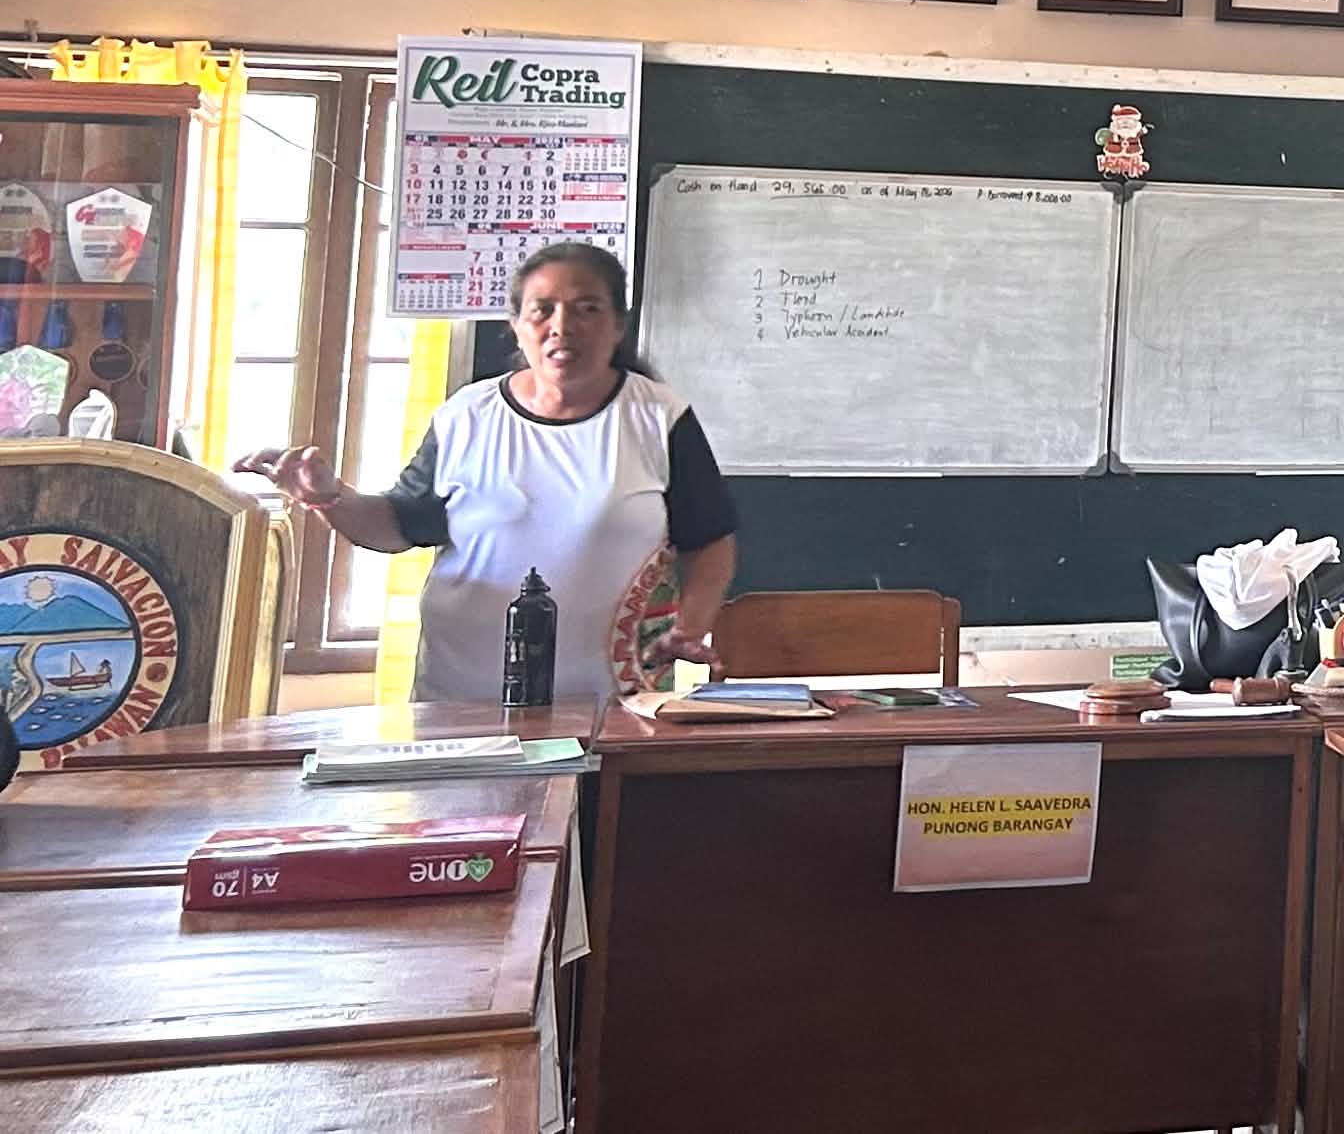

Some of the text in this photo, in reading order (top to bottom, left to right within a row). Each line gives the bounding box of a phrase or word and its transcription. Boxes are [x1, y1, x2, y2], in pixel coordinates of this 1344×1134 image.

[520, 64, 600, 87] Copra
[413, 55, 517, 108] Reil
[520, 85, 626, 108] Trading
[546, 151, 555, 161] 2
[409, 165, 554, 175] 3 4 5 6 7 8 9
[406, 179, 556, 190] 10 11 12 13 14 15 16
[710, 182, 722, 191] on
[406, 194, 421, 204] 17
[428, 194, 443, 204] 18
[451, 194, 466, 204] 19
[473, 194, 489, 204] 20
[497, 195, 511, 205] 21
[518, 195, 533, 205] 22
[541, 195, 556, 205] 23
[427, 209, 443, 219] 25
[450, 209, 466, 219] 26
[473, 209, 489, 219] 27
[495, 210, 511, 220] 28
[517, 210, 533, 220] 29
[540, 210, 555, 220] 30
[519, 237, 527, 247] 2
[608, 237, 616, 247] 6
[473, 252, 481, 261] 7
[495, 252, 504, 262] 8
[469, 267, 506, 277] 14 15
[779, 269, 837, 290] Drought
[468, 281, 506, 291] 21 22
[467, 296, 505, 306] 28 29
[61, 536, 177, 658] SALVACION
[907, 797, 1092, 815] HON. HELEN L. SAAVEDRA
[923, 818, 1074, 835] PUNONG BARANGAY
[252, 870, 280, 888] A4
[211, 880, 239, 897] 70
